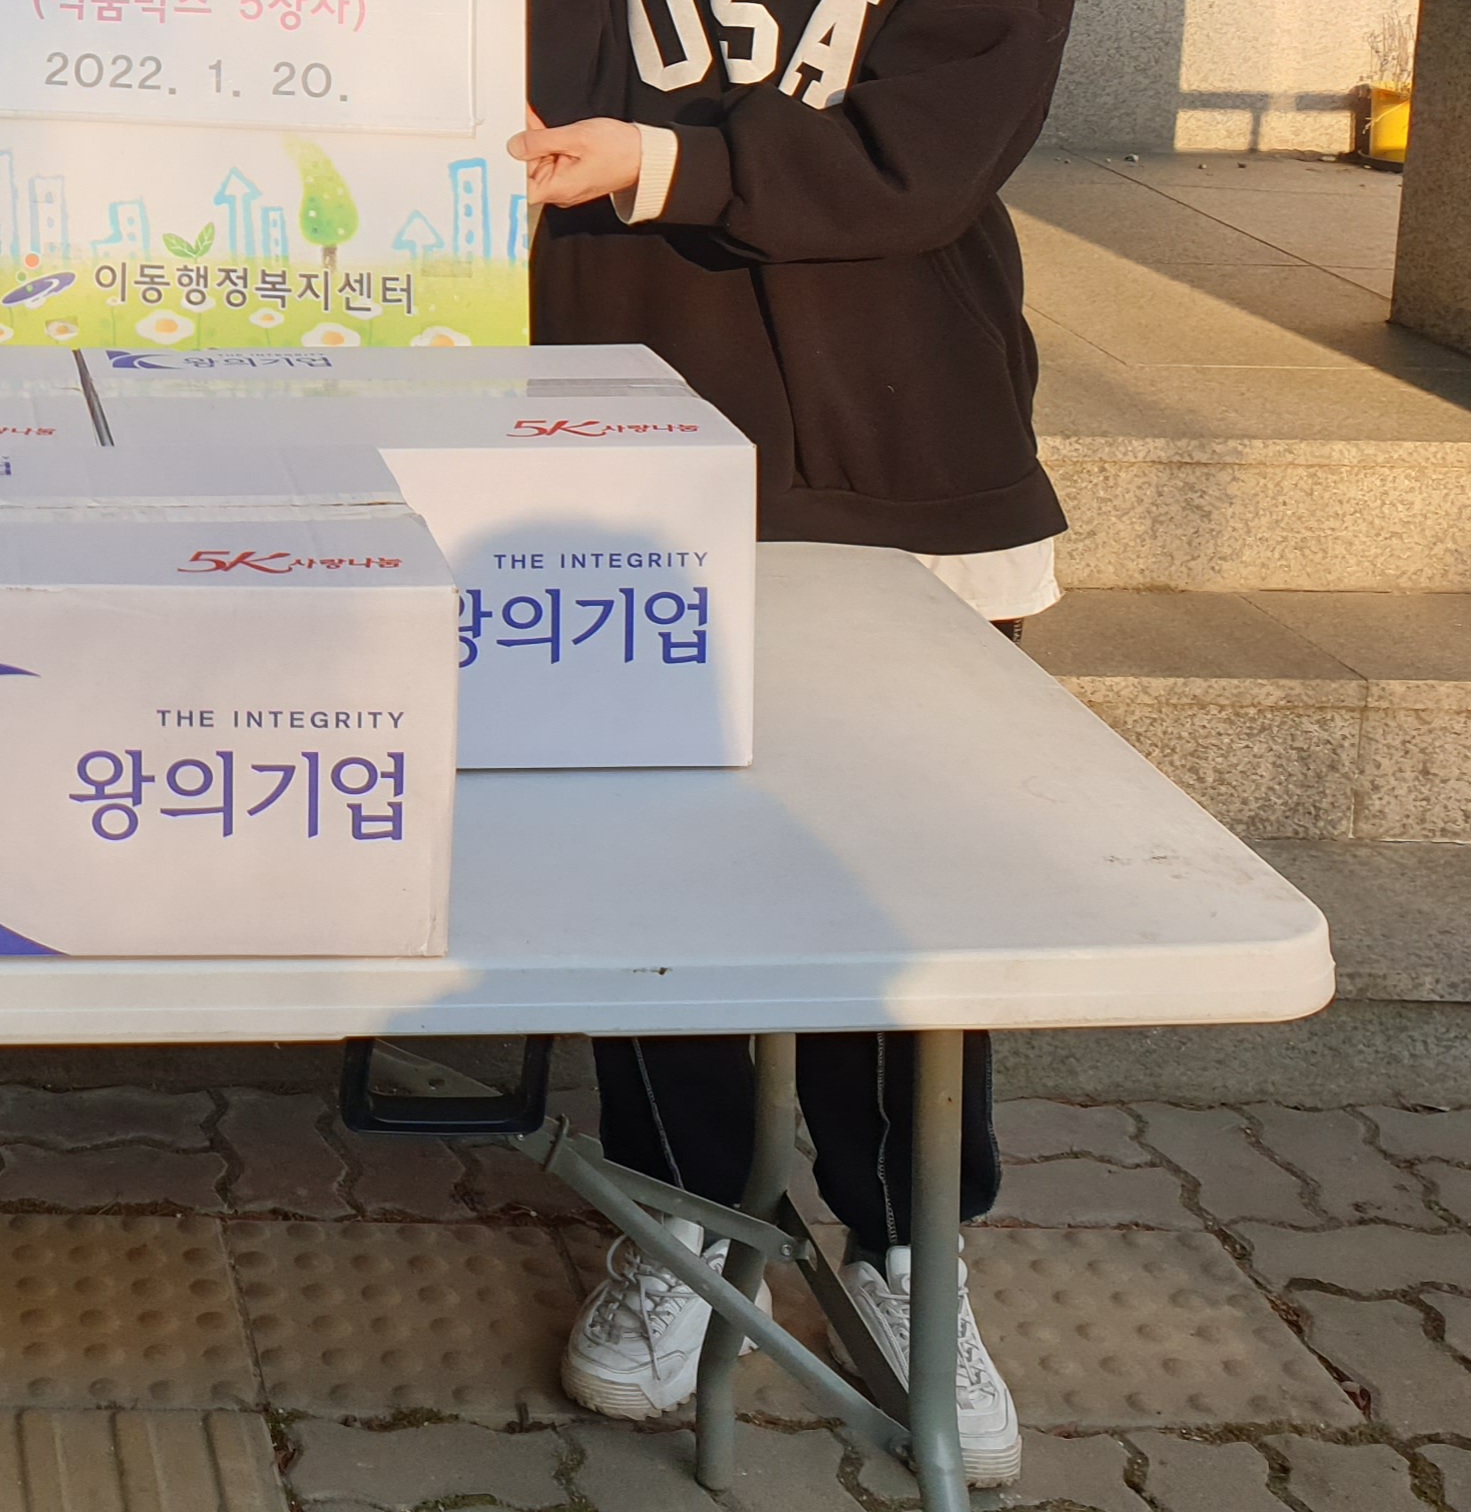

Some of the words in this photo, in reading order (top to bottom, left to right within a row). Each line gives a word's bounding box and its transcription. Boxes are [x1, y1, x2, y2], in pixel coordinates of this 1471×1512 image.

[44, 51, 178, 96] 2022.
[208, 58, 242, 97] 1.
[271, 61, 349, 102] 20.
[92, 261, 416, 316] 이동행정복지센터
[493, 553, 544, 569] THE
[560, 552, 708, 569] INTEGRITY
[156, 709, 215, 728] THE
[233, 710, 405, 729] INTEGRITY
[69, 749, 405, 841] 왕의기업
